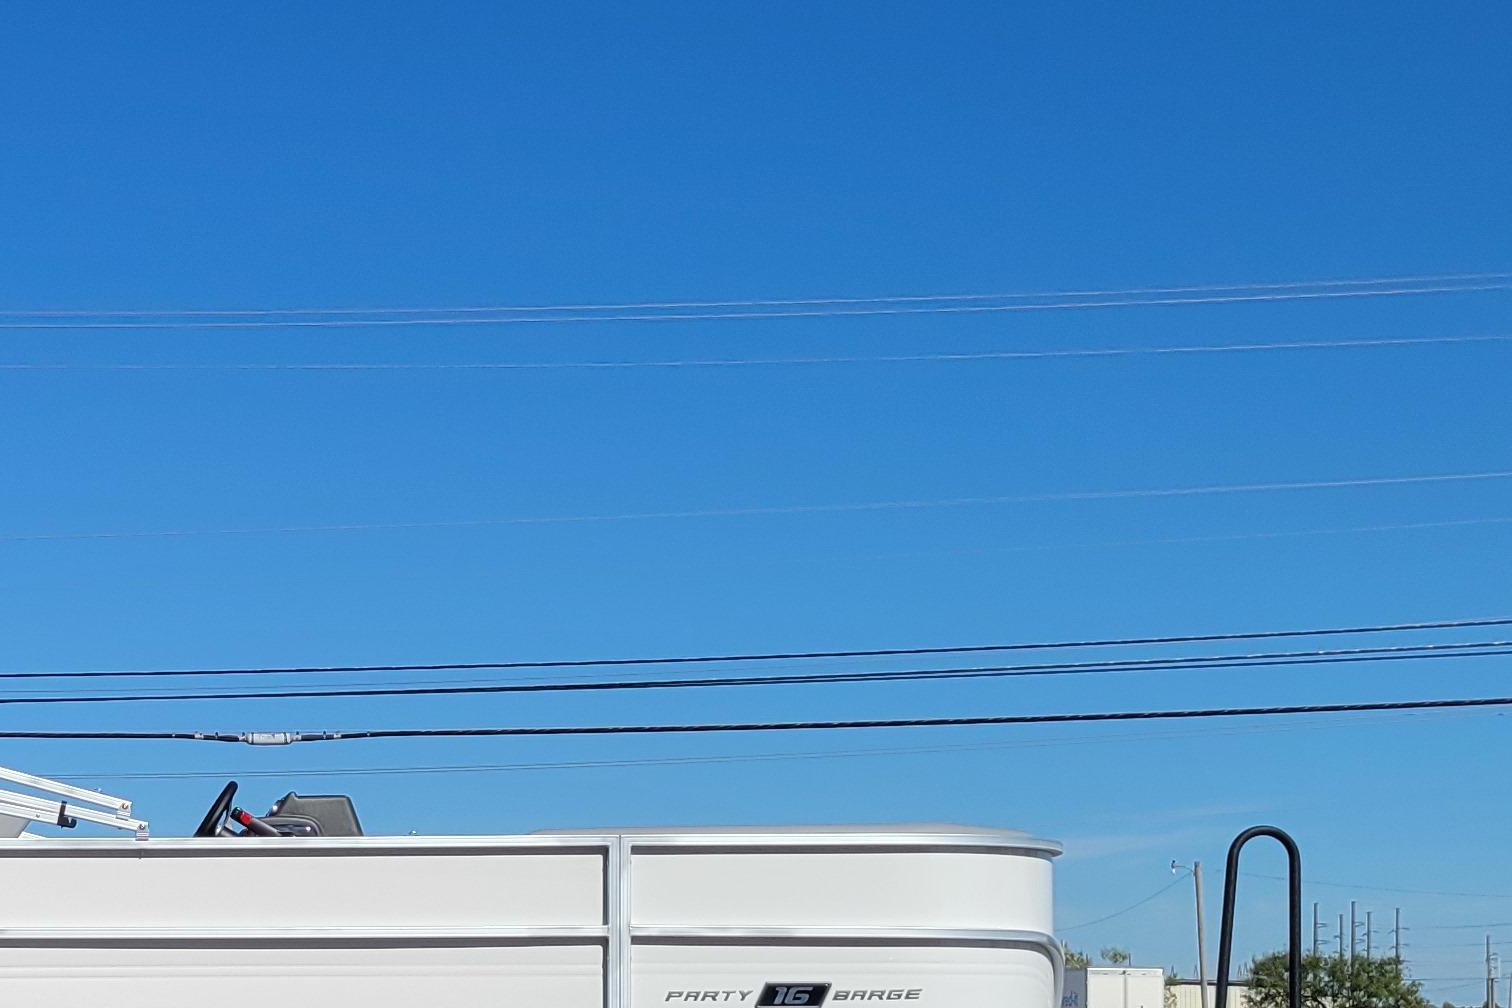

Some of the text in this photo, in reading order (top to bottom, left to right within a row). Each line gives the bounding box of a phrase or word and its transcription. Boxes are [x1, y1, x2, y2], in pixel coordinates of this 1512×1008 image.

[665, 986, 924, 1005] PARTY 16 BARGE
